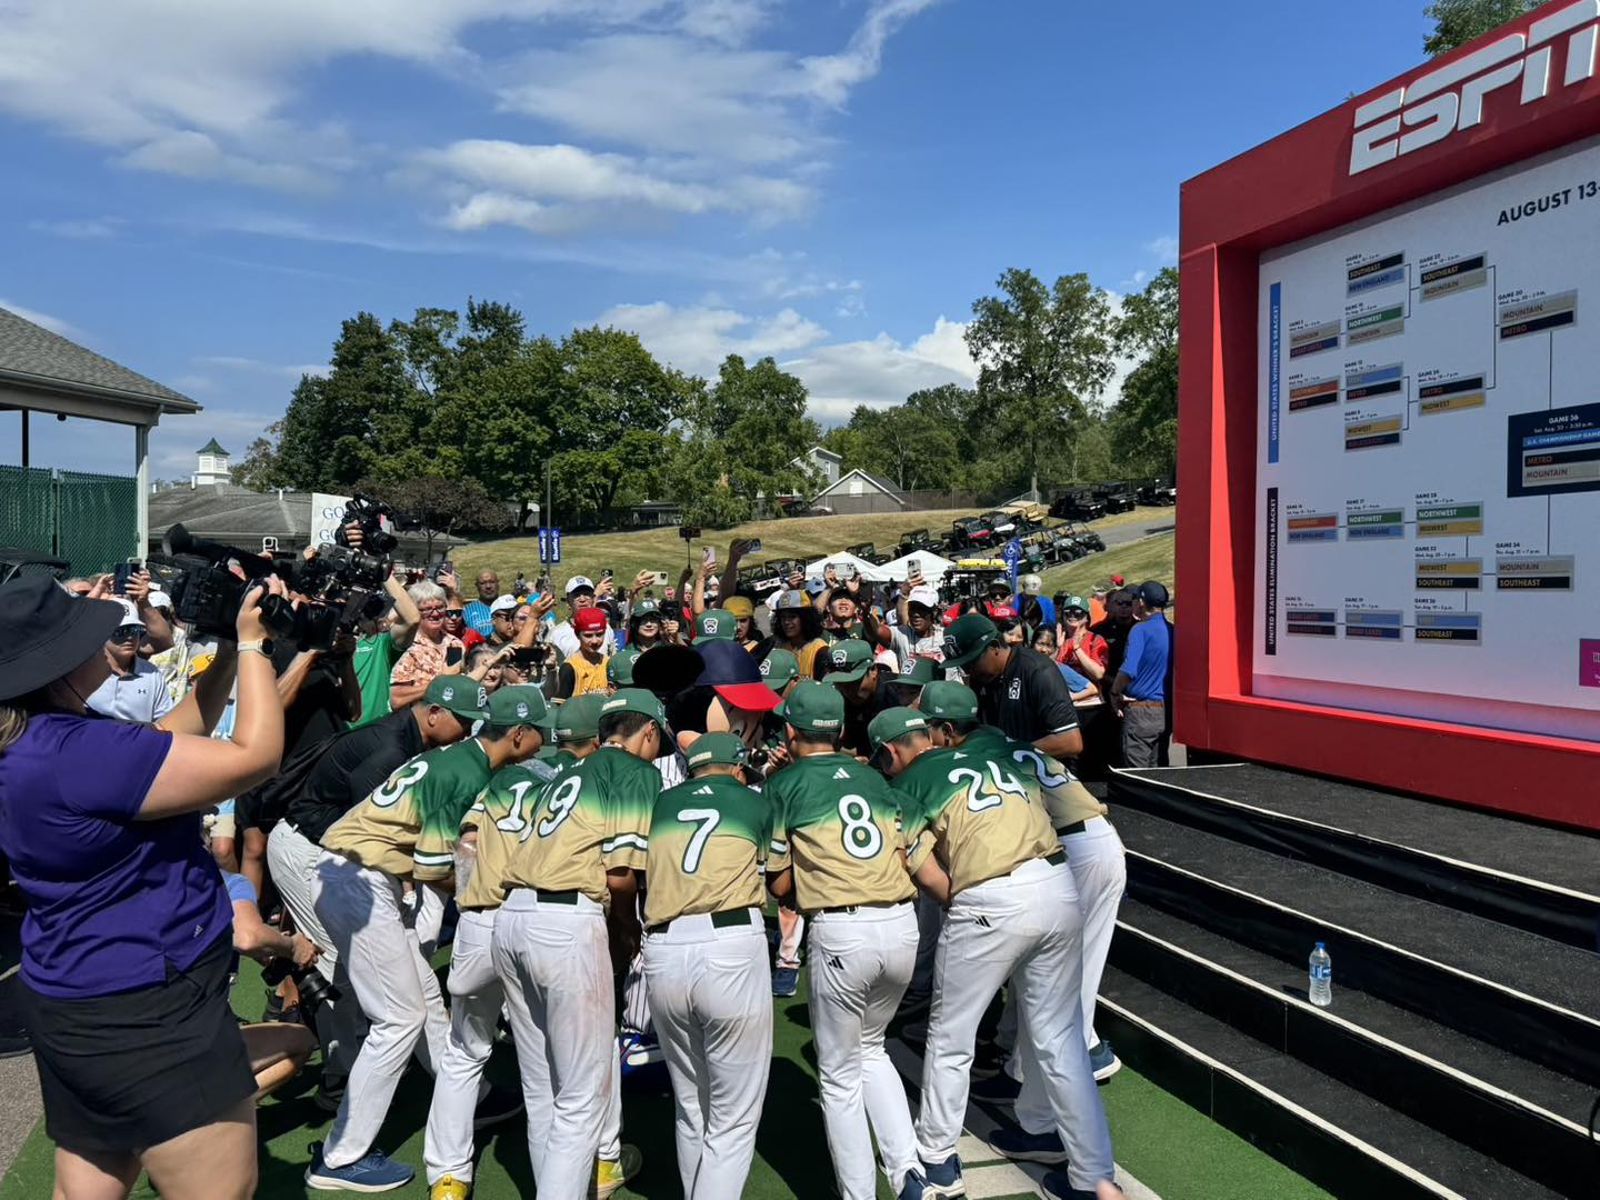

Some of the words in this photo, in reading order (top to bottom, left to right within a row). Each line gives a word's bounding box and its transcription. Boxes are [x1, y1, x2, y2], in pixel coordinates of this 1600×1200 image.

[1348, 0, 1600, 176] ESPN
[1496, 188, 1572, 226] AUGUST
[1503, 305, 1543, 319] MOUNTAIN
[1503, 325, 1527, 336] METRO
[1549, 415, 1569, 424] GAME
[1527, 456, 1553, 465] METRO
[1526, 468, 1568, 479] MOUNTAIN
[1419, 509, 1457, 518] NORTHWEST
[1349, 515, 1382, 523] NORTHWEST
[1420, 524, 1448, 532] MIDWEST
[1419, 563, 1447, 571] MIDWEST
[1499, 563, 1540, 571] MOUNTAIN
[1419, 579, 1454, 587] SOUTHEAST
[1500, 579, 1541, 587] SOUTHEAST
[1417, 630, 1453, 638] SOUTHEAST
[948, 760, 1030, 813] 24
[837, 792, 883, 860] 8
[677, 808, 721, 874] 7
